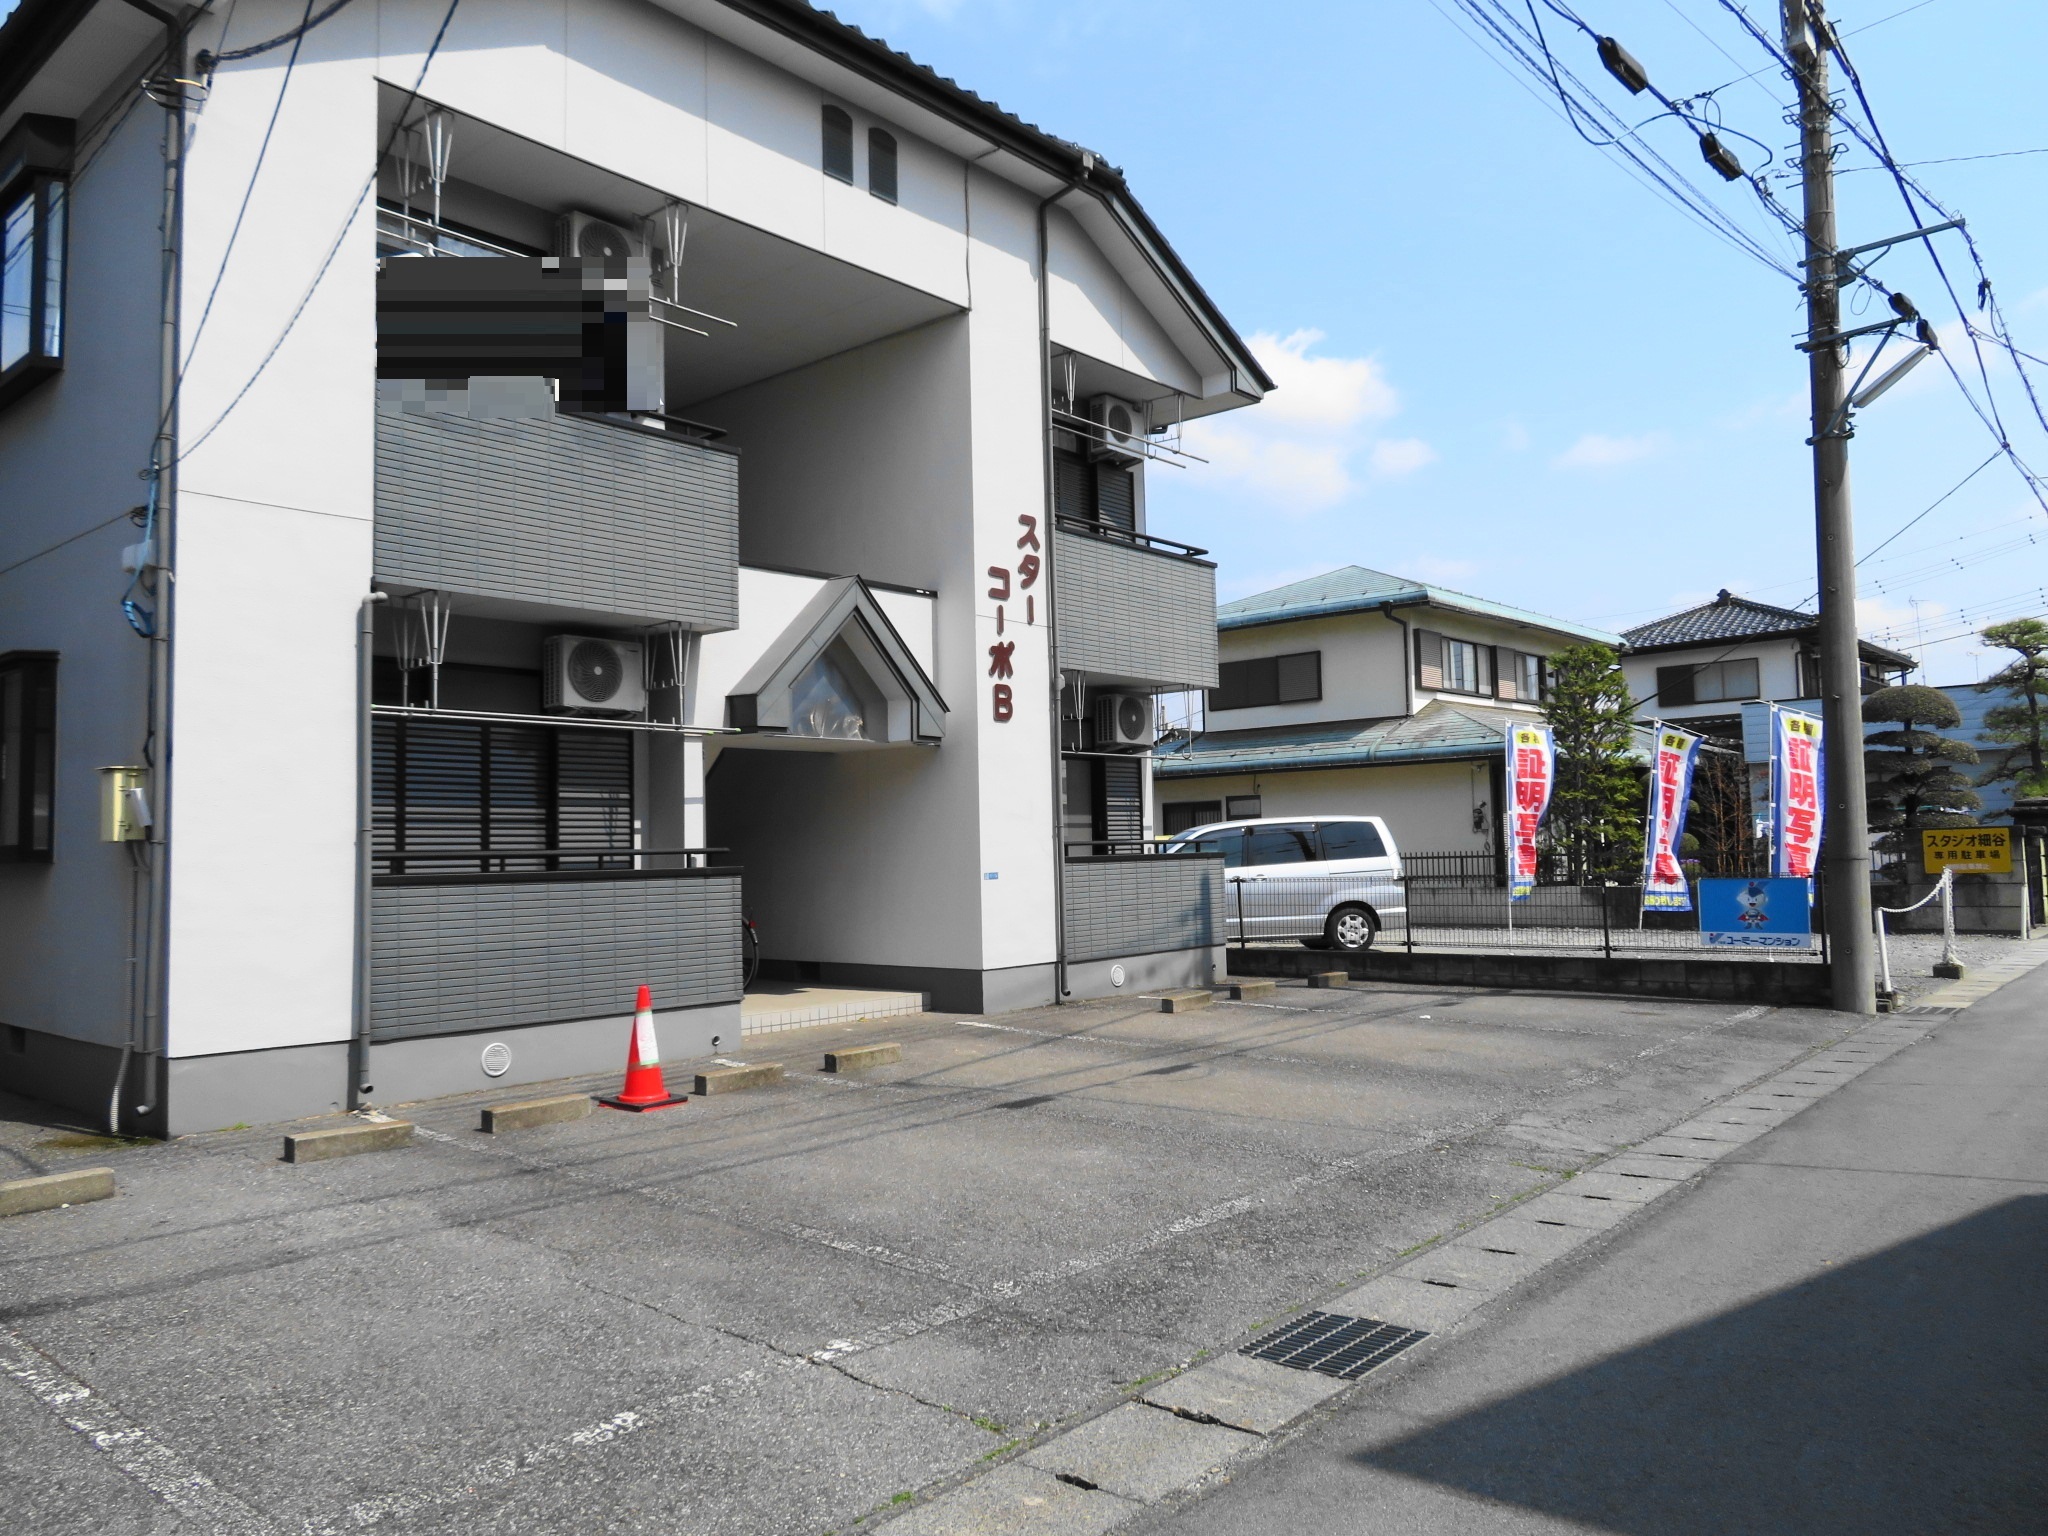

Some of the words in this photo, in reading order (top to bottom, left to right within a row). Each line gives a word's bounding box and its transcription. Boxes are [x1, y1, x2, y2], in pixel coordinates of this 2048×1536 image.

[1016, 513, 1041, 626] スター
[987, 565, 1015, 723] コーポB
[1514, 748, 1547, 876] 証明写真
[1785, 737, 1816, 878] 証明写真
[1927, 833, 2006, 848] スタジオ細谷
[1934, 850, 2001, 859] 専用駐車場
[1726, 936, 1800, 947] ユーミーマンション
